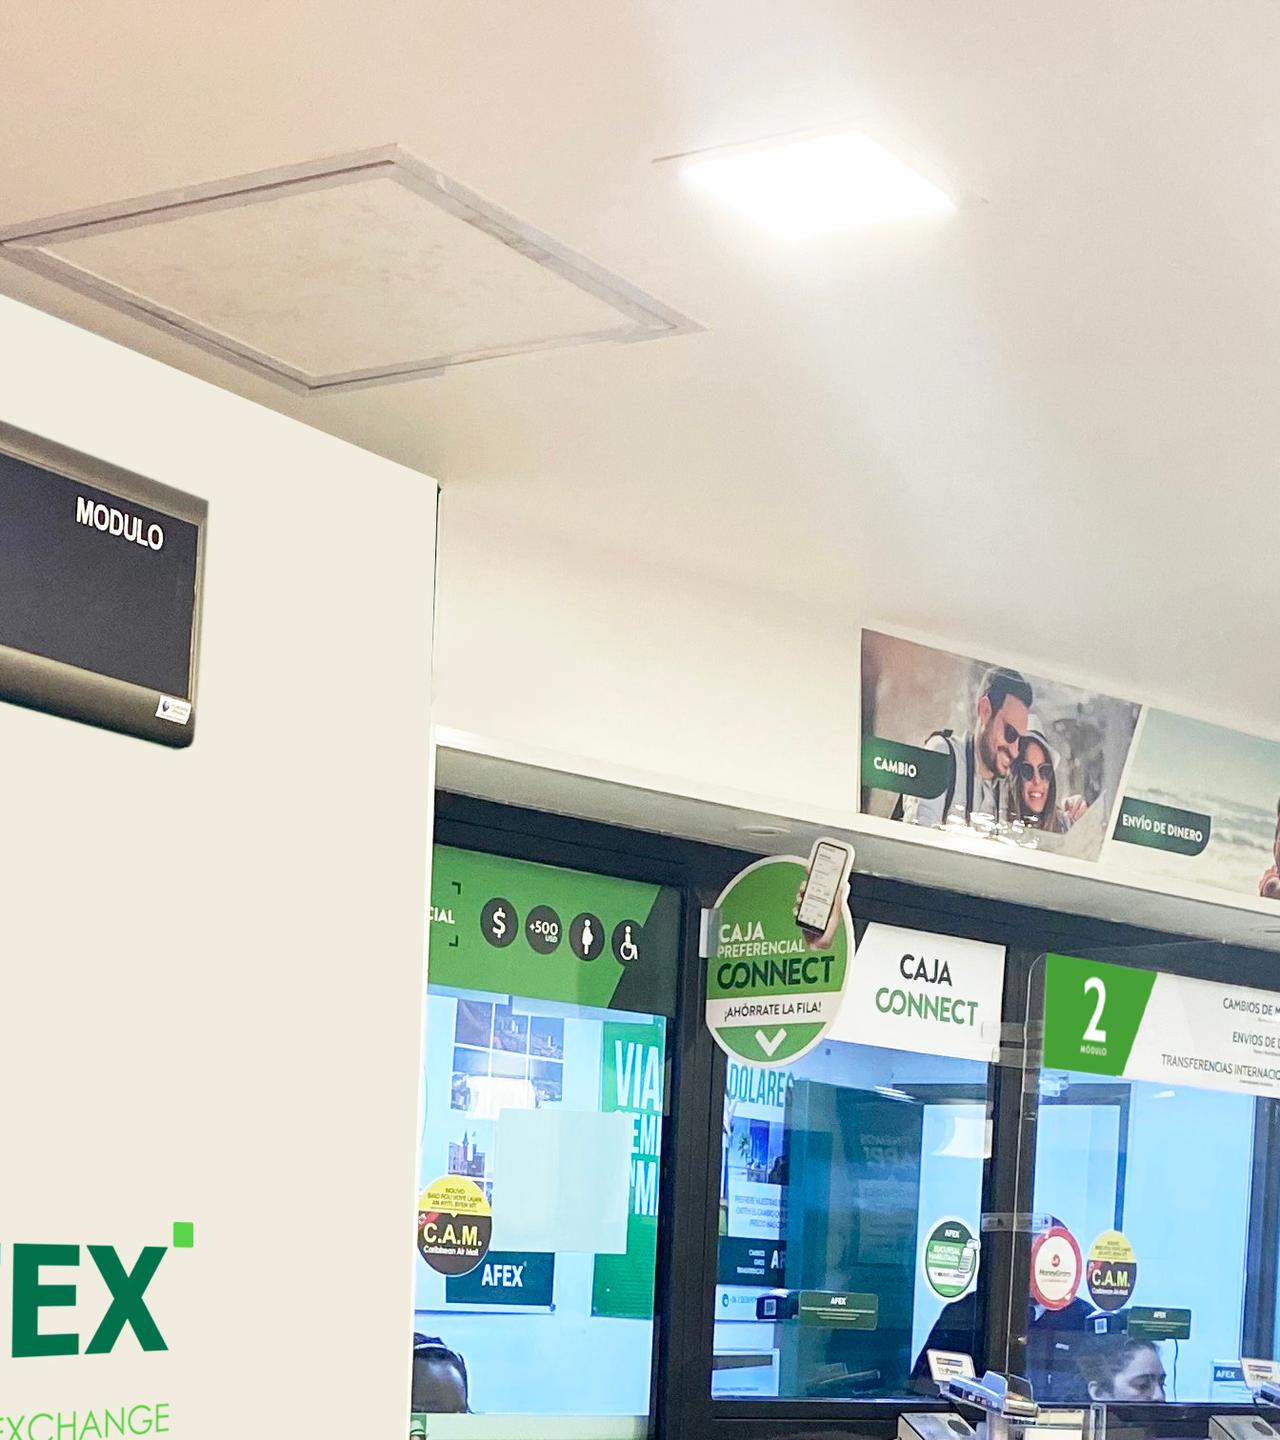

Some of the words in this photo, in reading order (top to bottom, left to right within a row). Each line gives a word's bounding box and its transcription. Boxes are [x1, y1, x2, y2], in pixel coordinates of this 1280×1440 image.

[75, 496, 164, 551] MODULO
[873, 755, 918, 779] CAMBIO
[1153, 820, 1166, 835] DE
[1167, 823, 1203, 843] DINERO
[544, 935, 558, 944] USD
[719, 920, 765, 943] CAJA
[717, 938, 806, 959] PREFERENCIAL
[717, 955, 835, 990] CONNECT
[900, 953, 952, 987] CAJA
[782, 1002, 796, 1015] LA
[797, 1000, 822, 1014] FILA!
[875, 987, 979, 1027] CONNECT
[1082, 976, 1107, 1043] 2
[1223, 997, 1260, 1014] CAMBIOS
[1261, 1004, 1273, 1015] DE
[1079, 1043, 1108, 1057] MÓDULO
[1265, 1036, 1276, 1048] DE
[1161, 1053, 1233, 1074] TRANSFERENCIAS
[423, 1222, 483, 1246] C.A.M.
[481, 1262, 524, 1288] AFEX
[1091, 1268, 1131, 1288] C.A.M.
